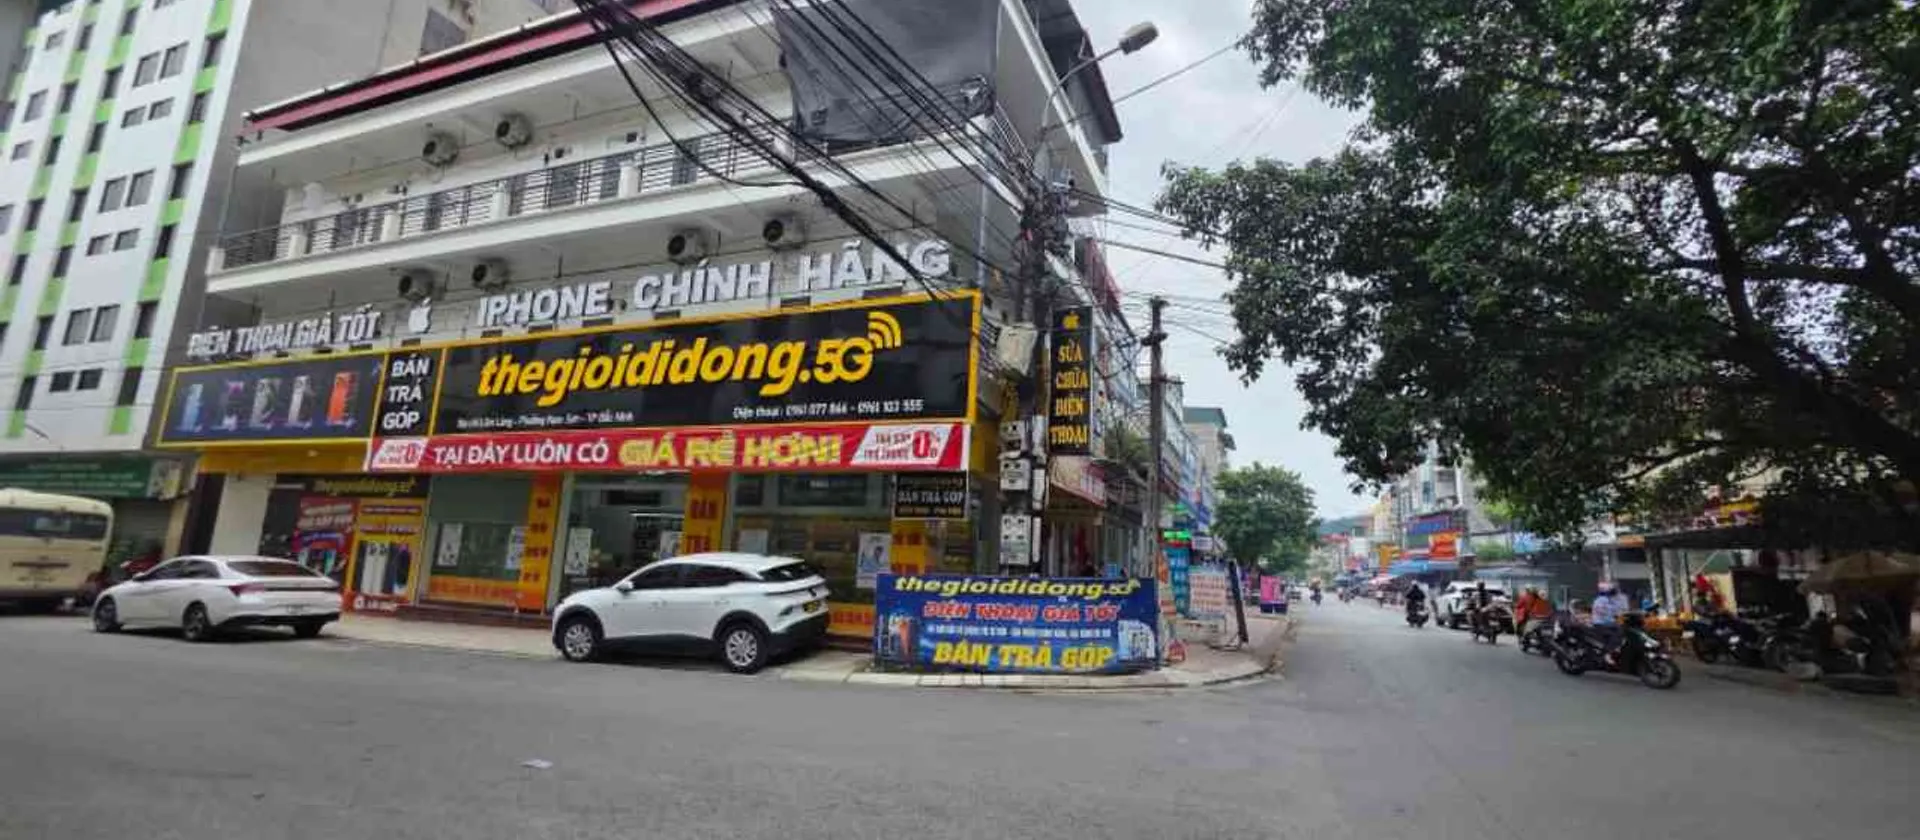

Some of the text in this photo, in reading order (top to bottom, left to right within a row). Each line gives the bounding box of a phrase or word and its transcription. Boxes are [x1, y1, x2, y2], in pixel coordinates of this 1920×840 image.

[476, 239, 950, 328] IPHONE CHÍNH HÃNG
[337, 304, 381, 344] TỐT
[390, 353, 431, 377] BÁN
[382, 404, 420, 430] GÓP
[432, 446, 464, 469] TẠI
[468, 440, 508, 465] ĐÂY
[512, 438, 571, 464] LUÔN
[575, 439, 608, 463] CÓ
[618, 431, 678, 466] GIÁ
[933, 639, 992, 666] BÁN
[1060, 642, 1116, 669] GÓP
